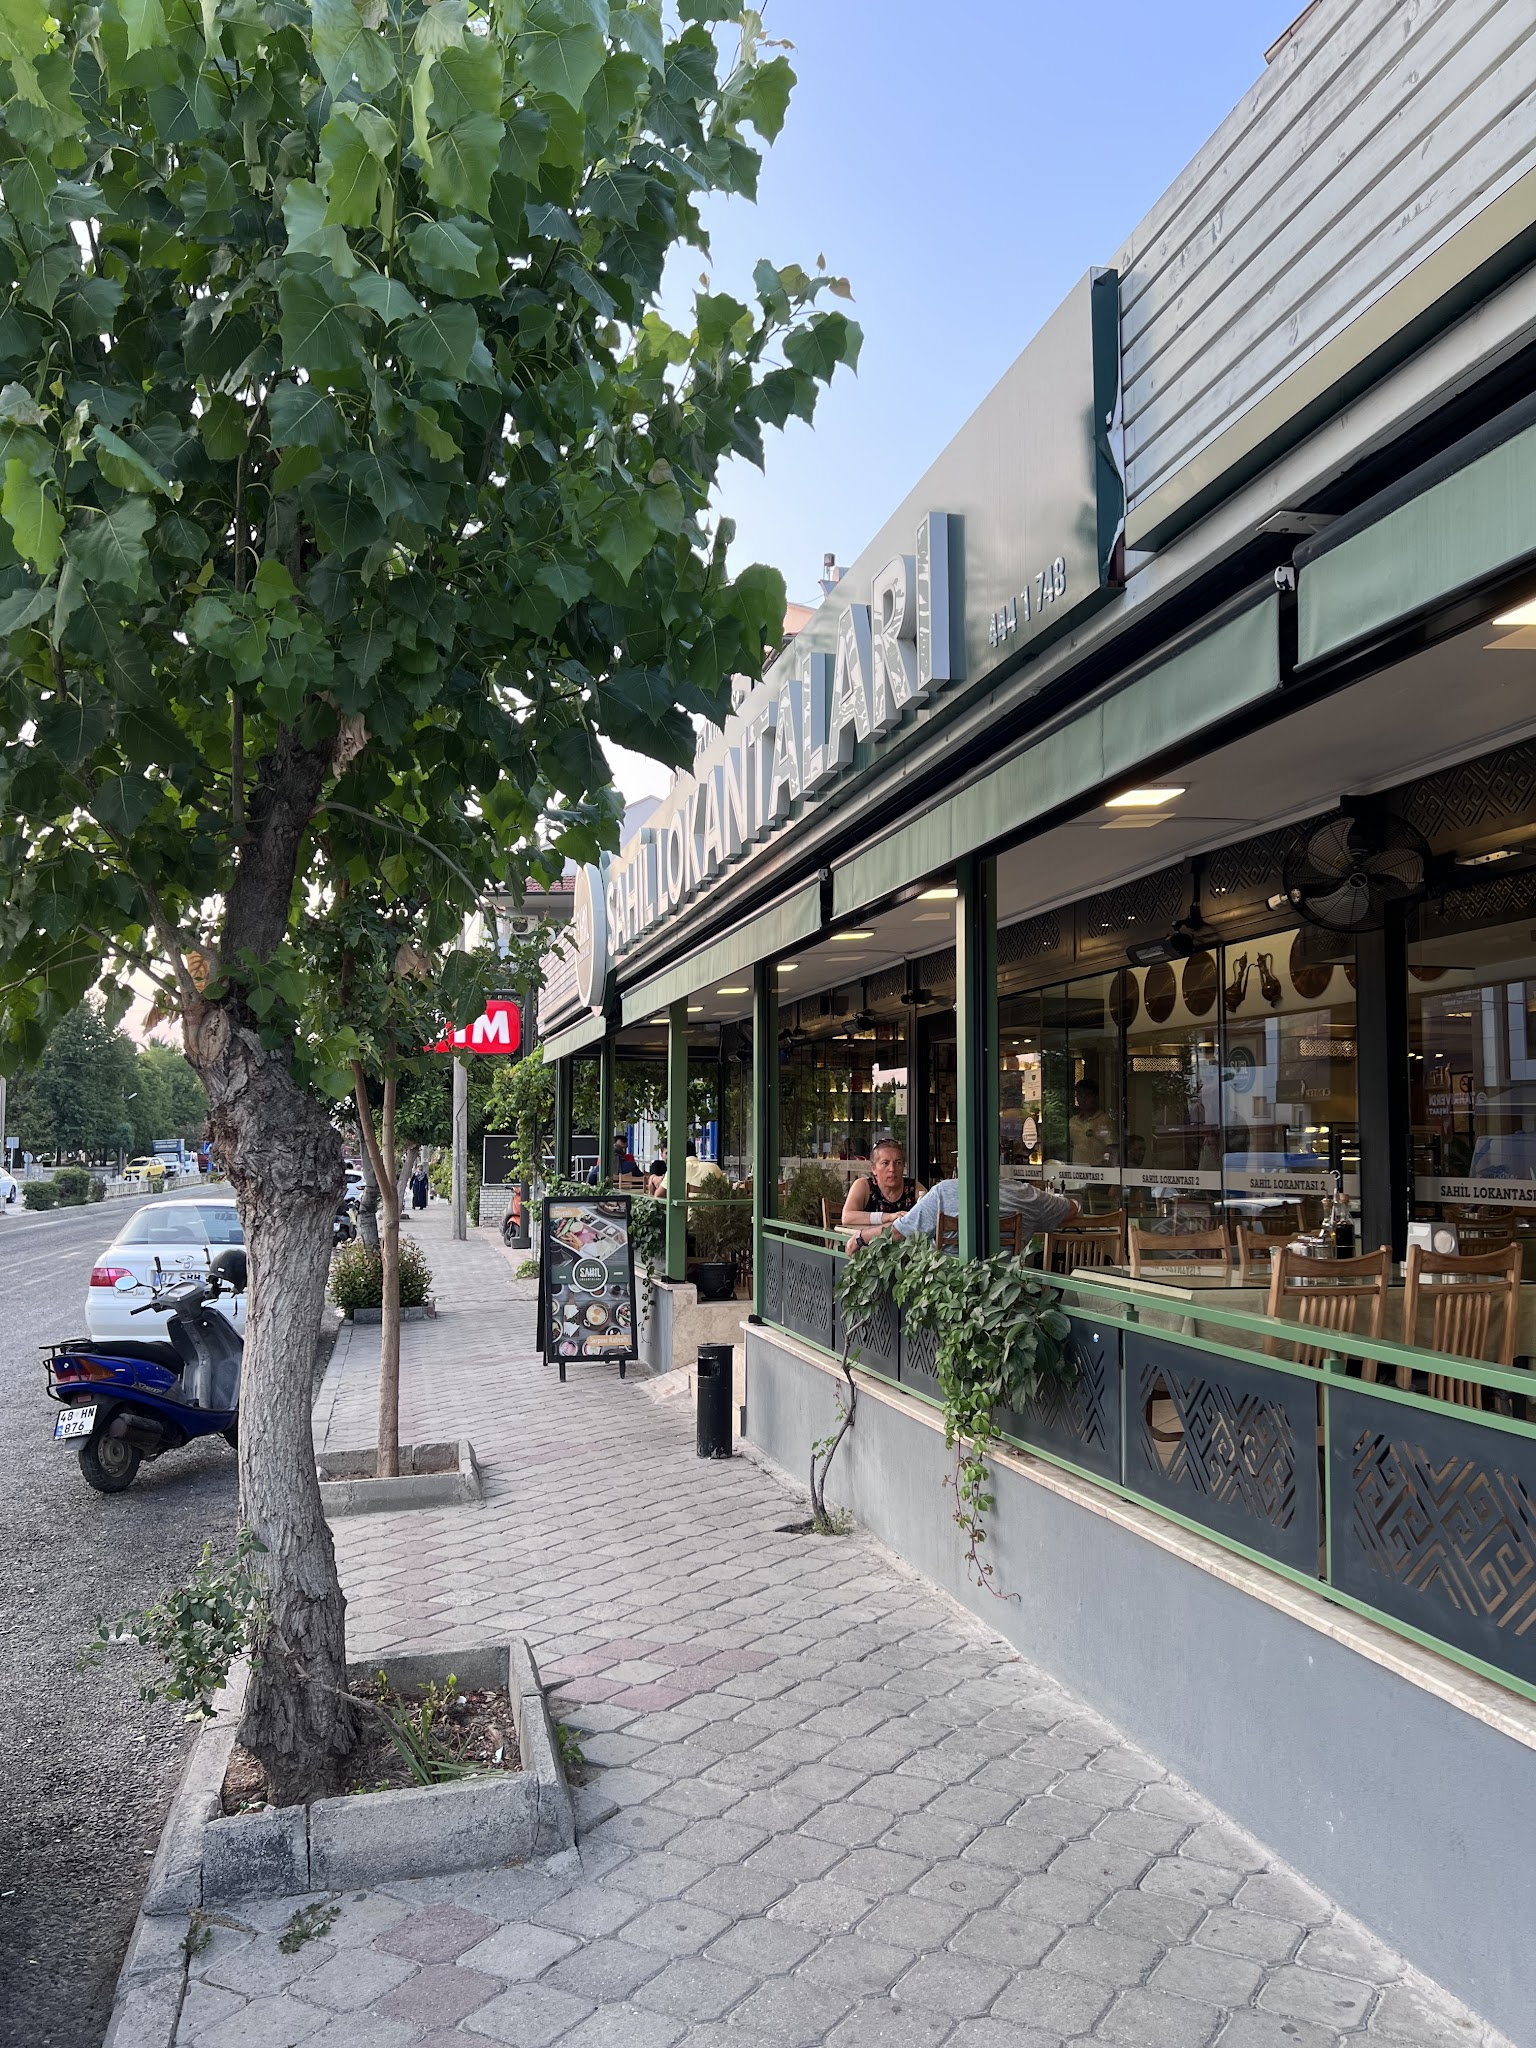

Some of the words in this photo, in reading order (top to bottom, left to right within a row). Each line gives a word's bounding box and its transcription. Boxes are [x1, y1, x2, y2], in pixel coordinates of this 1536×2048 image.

[989, 596, 1017, 648] 444
[1020, 585, 1031, 622] 1
[1034, 556, 1067, 613] 748
[656, 512, 949, 920] LOKANTALARI
[1100, 1172, 1104, 1181] 2
[1160, 1175, 1195, 1186] LOKANTASI
[1195, 1176, 1200, 1186] 2
[1273, 1179, 1319, 1191] LOKANTASI
[1320, 1180, 1326, 1191] 2
[1440, 1182, 1471, 1198] SAHİL
[60, 1411, 74, 1423] 48
[81, 1407, 95, 1419] HN
[64, 1421, 85, 1434] 876
